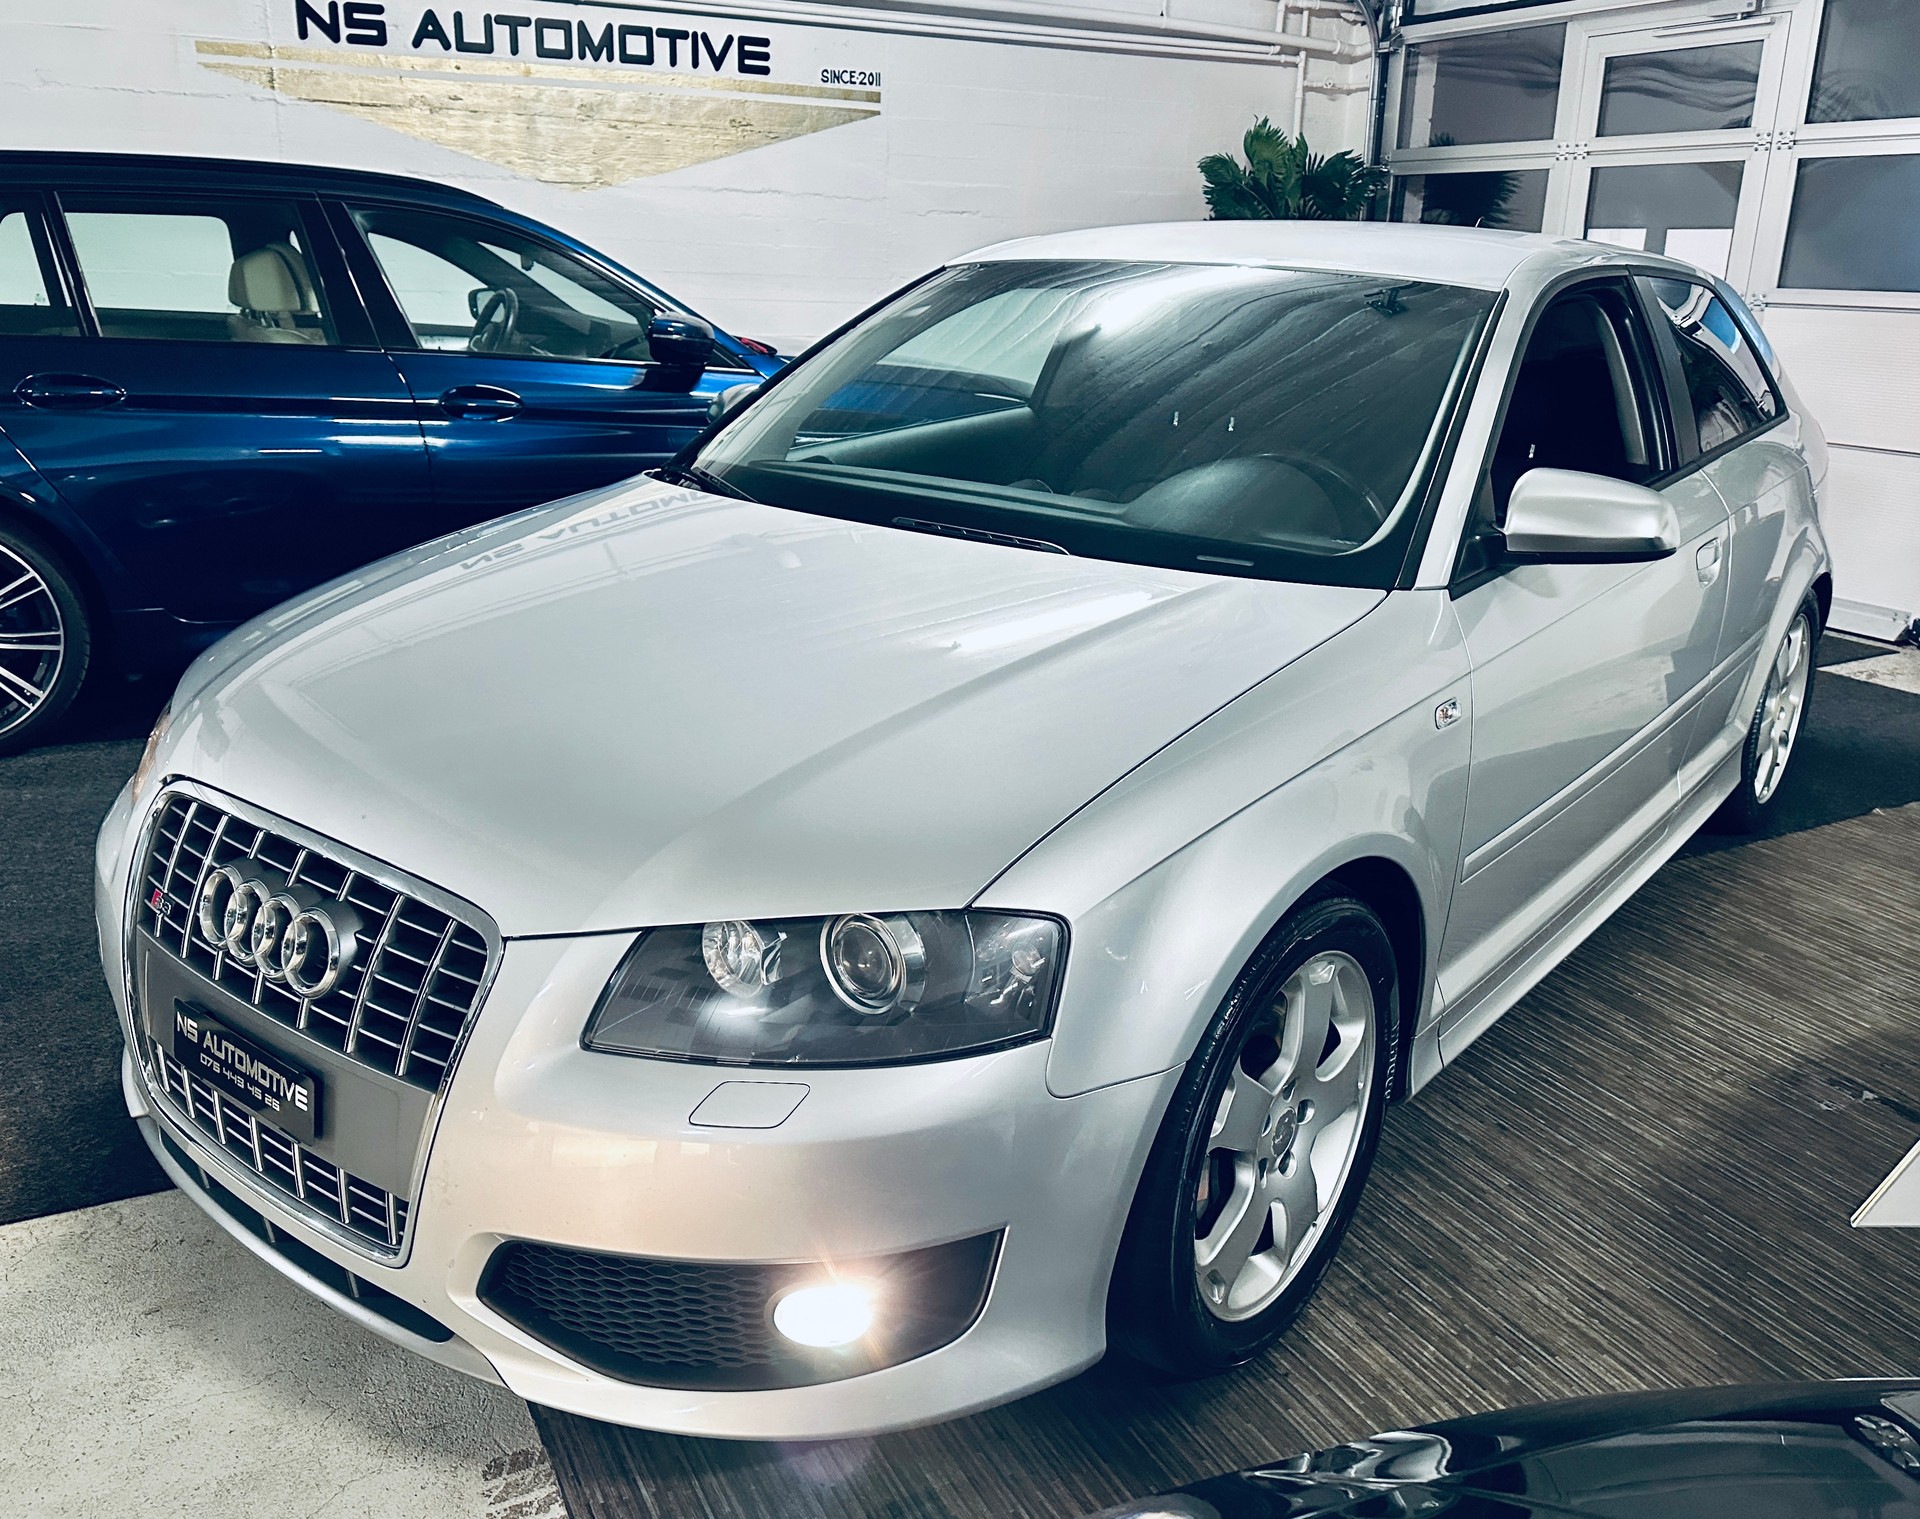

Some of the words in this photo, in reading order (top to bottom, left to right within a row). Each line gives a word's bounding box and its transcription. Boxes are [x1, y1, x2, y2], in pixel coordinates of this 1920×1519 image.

[296, 0, 388, 46] NS
[412, 9, 770, 75] AUTOMOTIVE
[176, 1011, 198, 1043] NS
[203, 1030, 308, 1112] AUTOMOTIVE
[222, 1067, 244, 1089] 443
[247, 1082, 262, 1101] 45
[264, 1093, 280, 1112] 26
